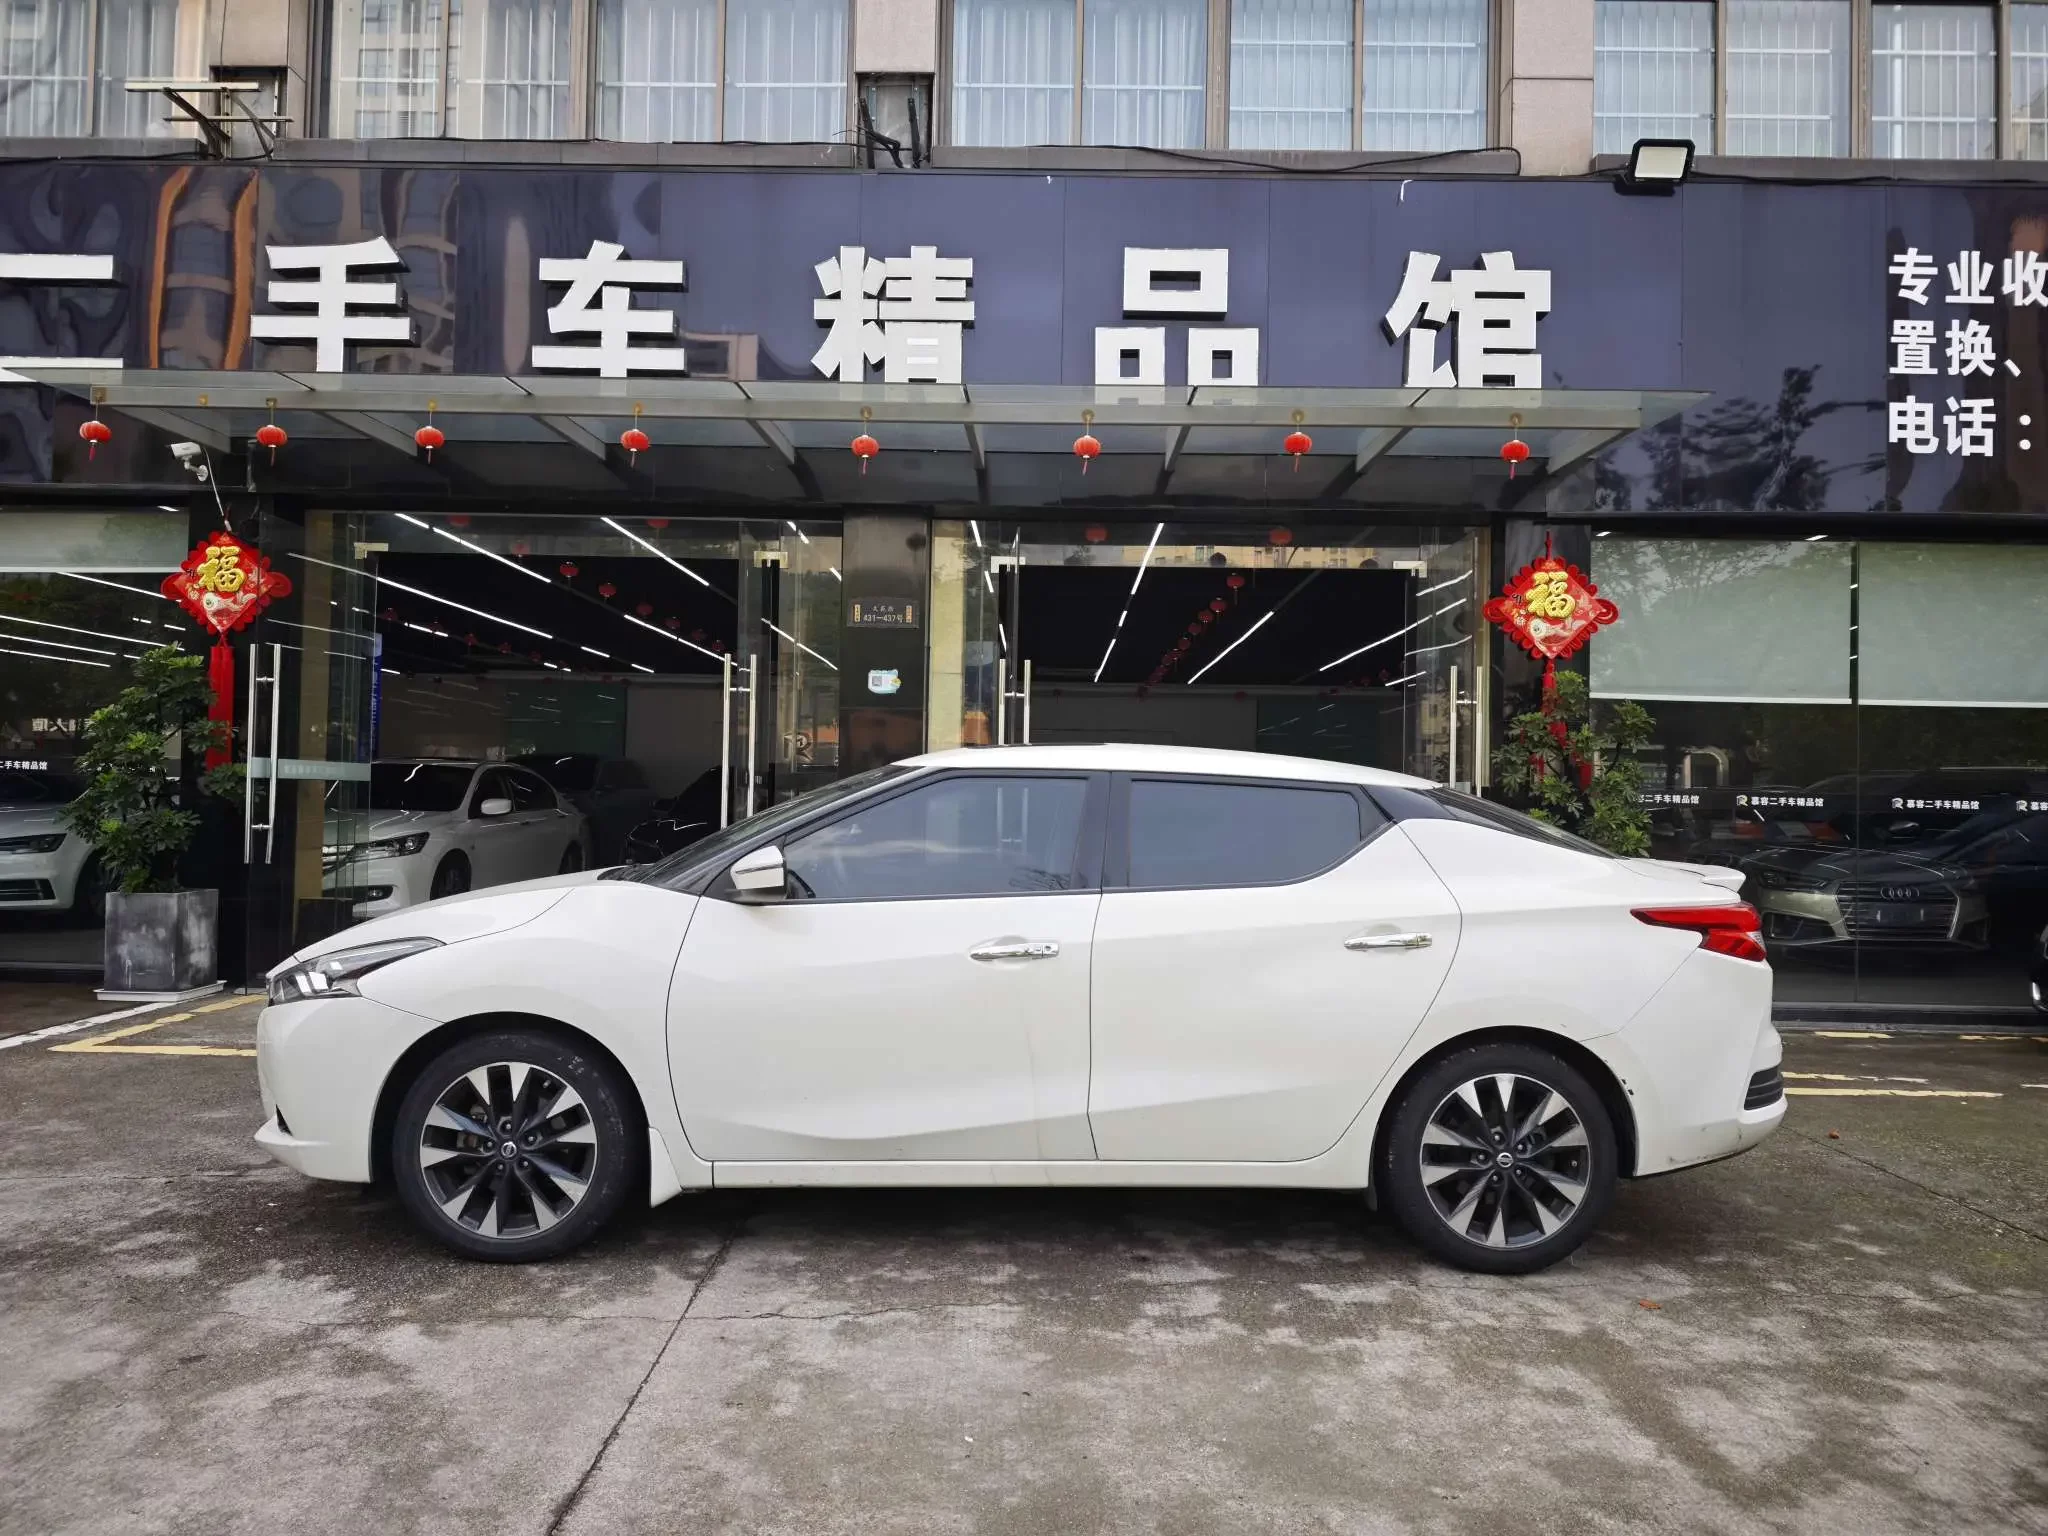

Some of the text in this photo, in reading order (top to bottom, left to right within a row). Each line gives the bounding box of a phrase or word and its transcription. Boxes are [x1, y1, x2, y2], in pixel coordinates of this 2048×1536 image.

[1889, 247, 2048, 307] 专业收
[0, 236, 1551, 389] 二手车精品馆
[197, 546, 245, 592] 福
[1526, 571, 1576, 618] 福
